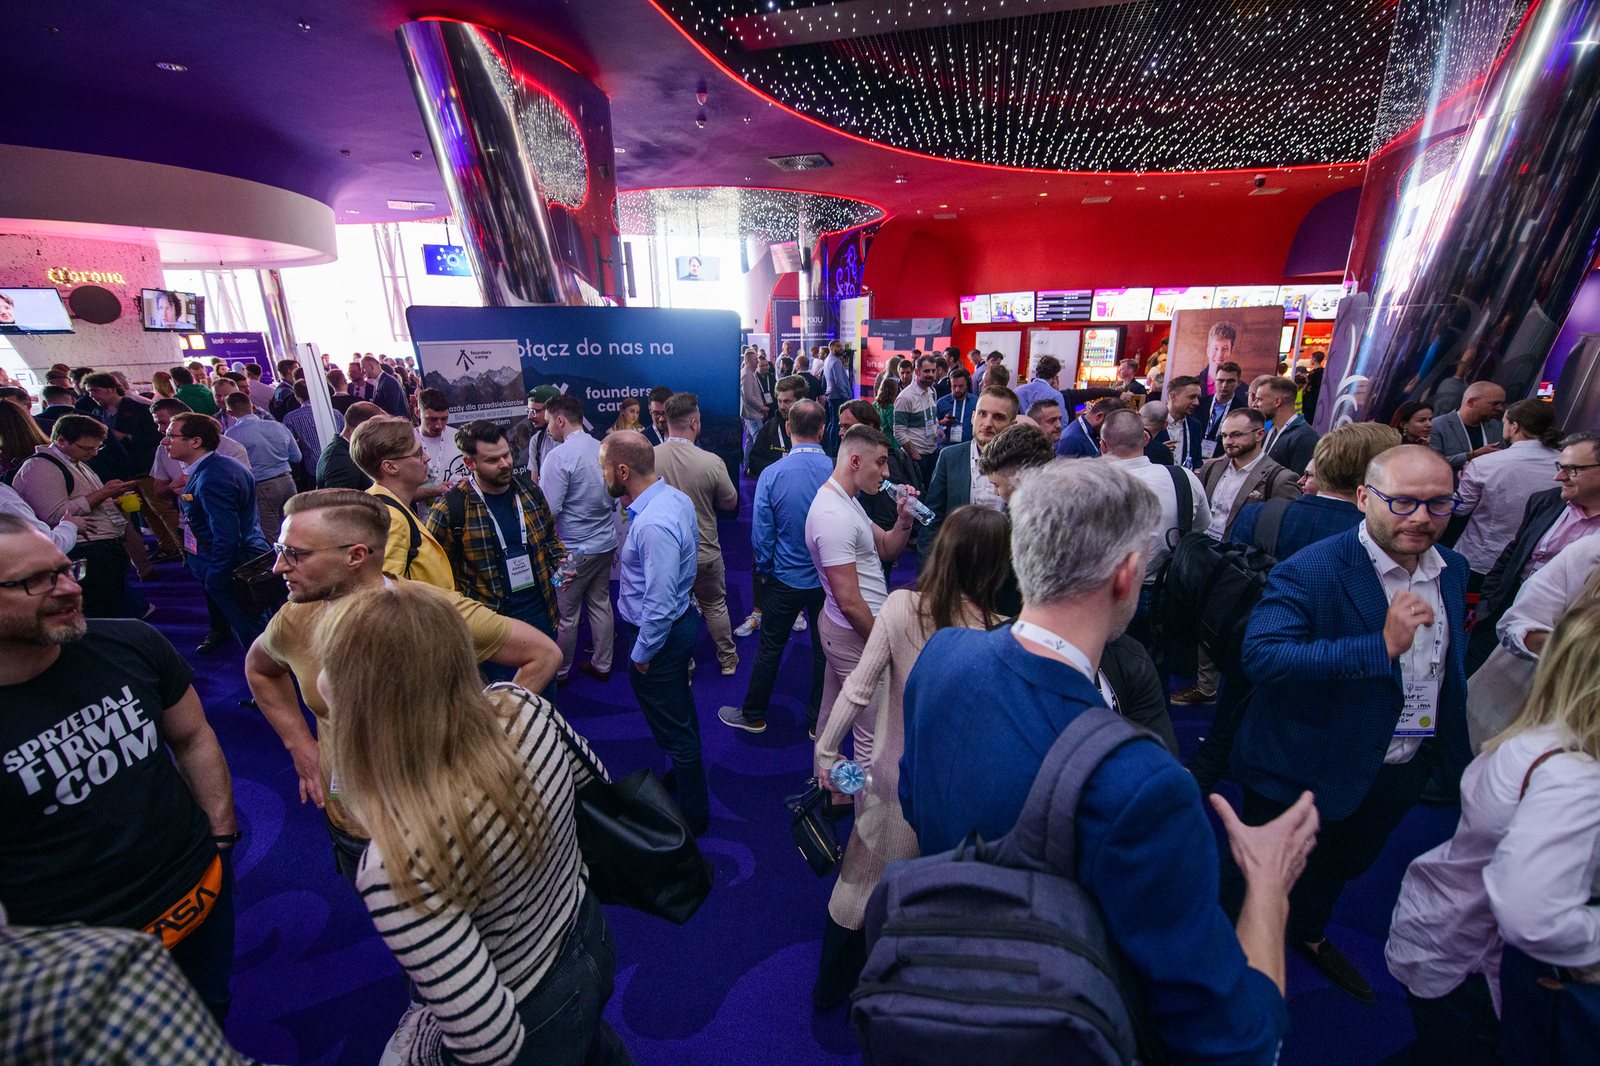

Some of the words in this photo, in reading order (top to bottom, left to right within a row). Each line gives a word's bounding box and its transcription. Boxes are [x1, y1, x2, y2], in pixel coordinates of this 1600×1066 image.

[47, 267, 126, 288] Corona
[518, 338, 569, 361] ołącz
[576, 337, 602, 356] do
[609, 342, 643, 356] nas
[650, 342, 674, 355] na
[585, 385, 652, 399] founders
[449, 404, 464, 413] azdy
[465, 403, 476, 411] dla
[477, 400, 524, 410] przedsiębiorców
[455, 412, 483, 420] Biznesowe
[487, 409, 512, 418] warsztaty
[597, 401, 623, 412] ca
[3, 685, 133, 773] SPRZEDAJ
[18, 699, 149, 796] FIRME
[43, 720, 158, 815] .COM
[154, 887, 217, 940] ASA
